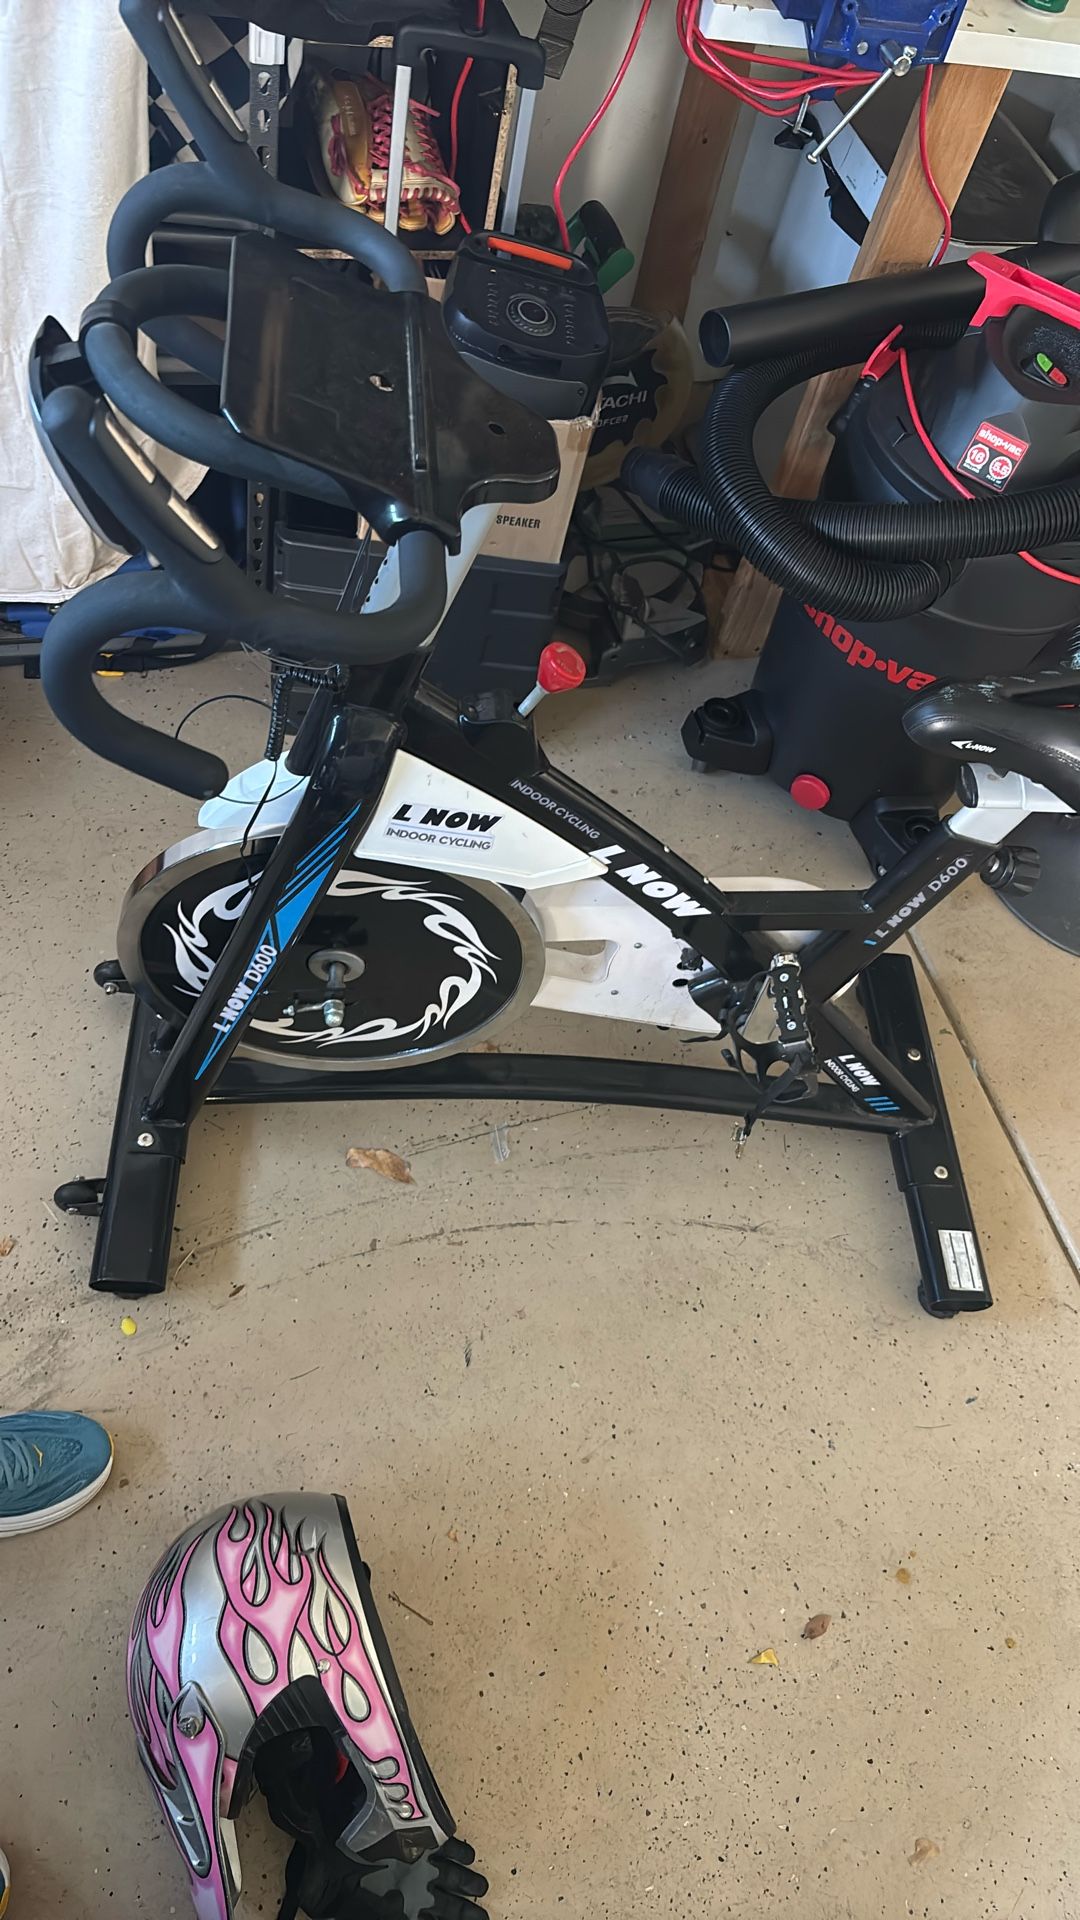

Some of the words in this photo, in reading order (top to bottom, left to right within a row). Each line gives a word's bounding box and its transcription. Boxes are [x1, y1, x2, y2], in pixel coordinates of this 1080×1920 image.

[600, 390, 648, 409] ACHI
[496, 514, 541, 529] SPEAKER
[392, 803, 413, 822] L
[419, 807, 503, 832] NOW
[510, 779, 557, 811] INDOOR
[555, 807, 600, 839] CYCLING
[386, 827, 436, 843] INDOOR
[439, 835, 491, 850] CYCLING
[588, 844, 626, 865] L
[614, 863, 712, 917] NOW
[874, 929, 889, 938] L
[886, 891, 926, 928] NOW
[928, 858, 968, 892] D600
[243, 944, 278, 983] D600
[219, 981, 253, 1022] NOW
[212, 1022, 231, 1033] L
[838, 1054, 856, 1063] L
[845, 1062, 881, 1086] NOW
